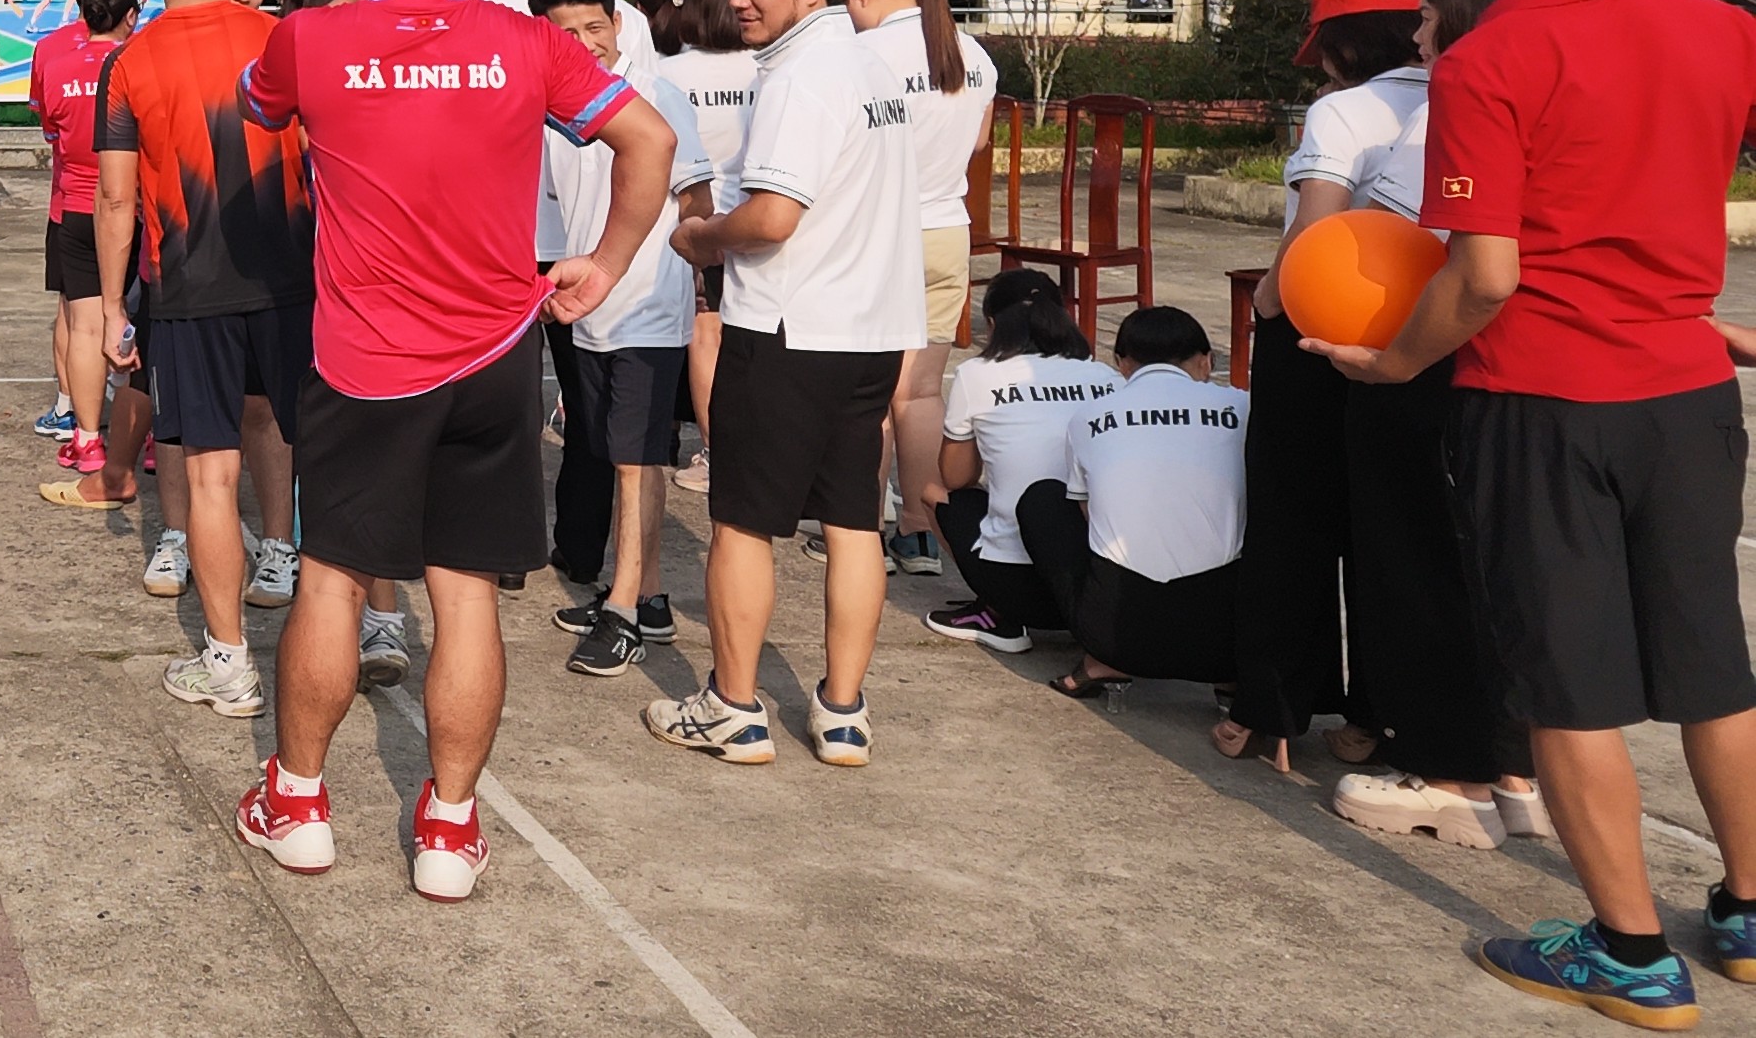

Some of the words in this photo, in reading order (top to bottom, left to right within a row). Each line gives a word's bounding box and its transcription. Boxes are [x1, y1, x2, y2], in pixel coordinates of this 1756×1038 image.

[344, 58, 387, 89] XÃ
[393, 65, 461, 89] LINH
[467, 53, 507, 89] HỒ
[905, 71, 926, 94] XÃ
[704, 90, 744, 106] LINH
[991, 382, 1024, 407] XÃ
[1029, 384, 1086, 402] LINH
[1087, 411, 1119, 439] XÃ
[1126, 408, 1191, 426] LINH
[1200, 405, 1240, 430] HỒ
